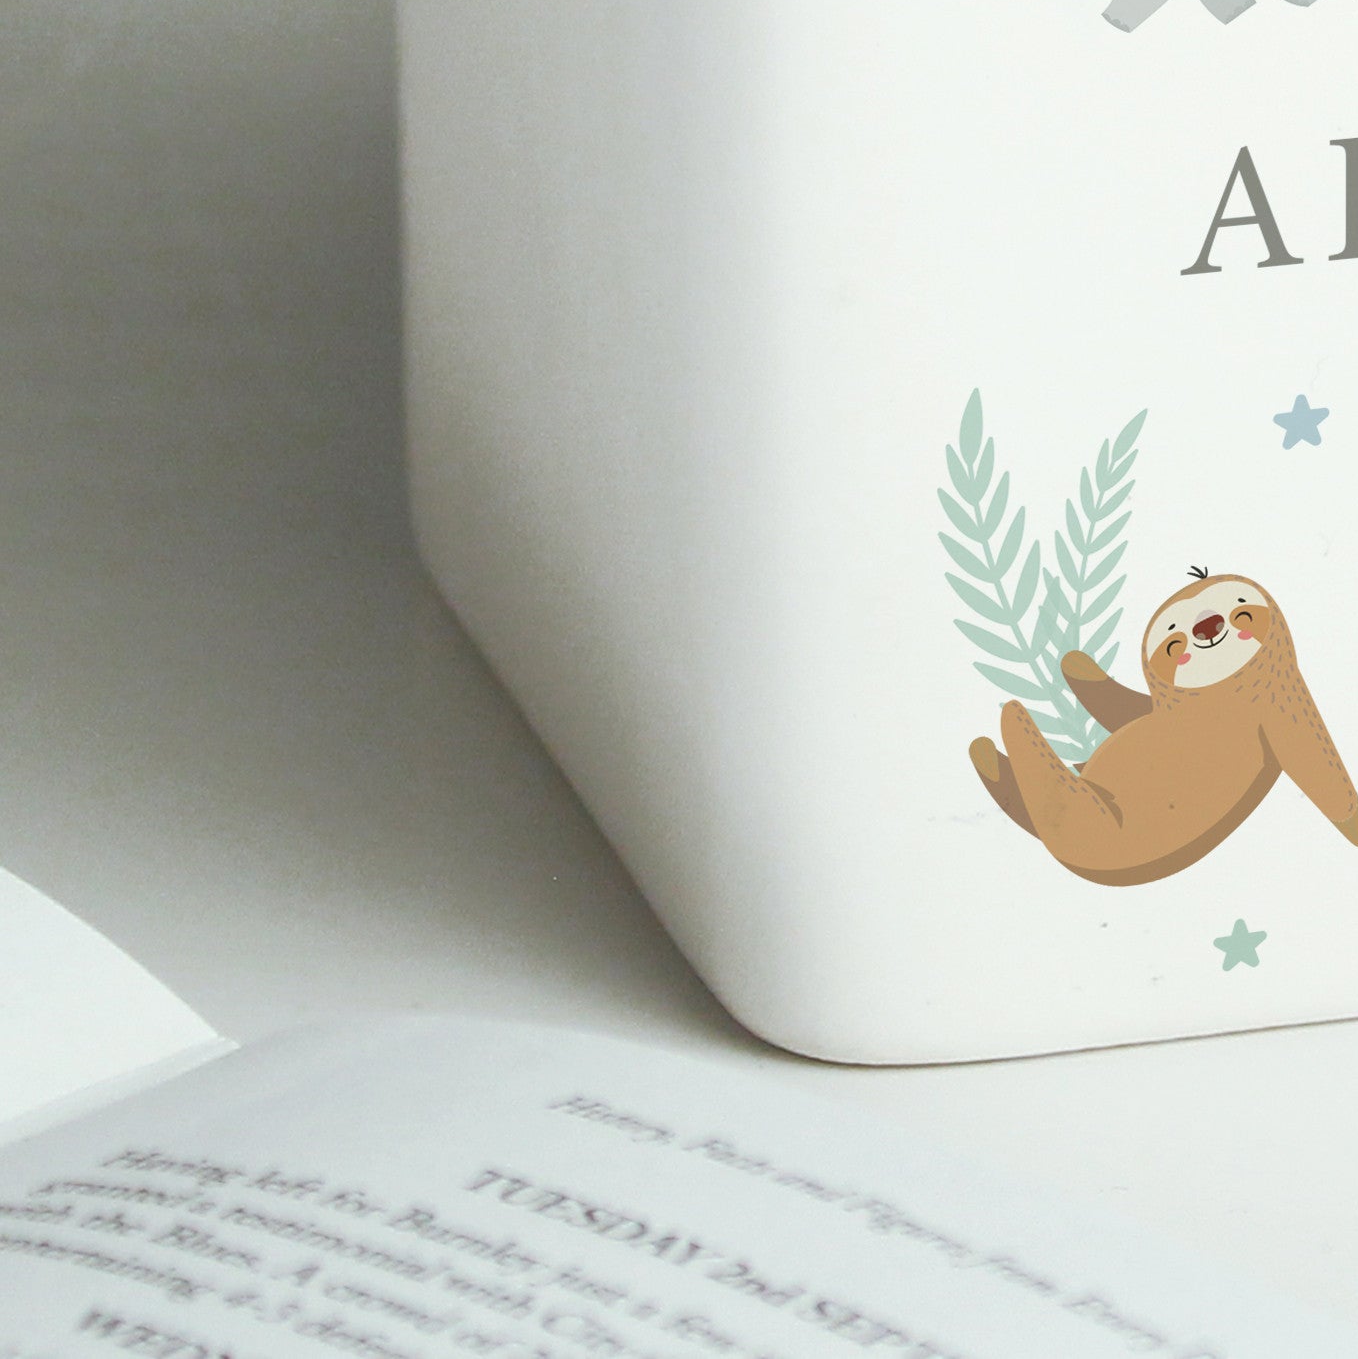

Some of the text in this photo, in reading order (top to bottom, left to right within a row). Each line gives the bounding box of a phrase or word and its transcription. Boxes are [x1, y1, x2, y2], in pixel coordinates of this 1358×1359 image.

[316, 1190, 388, 1219] for
[464, 1168, 726, 1267] TUESDAY
[706, 1261, 807, 1308] 2nd
